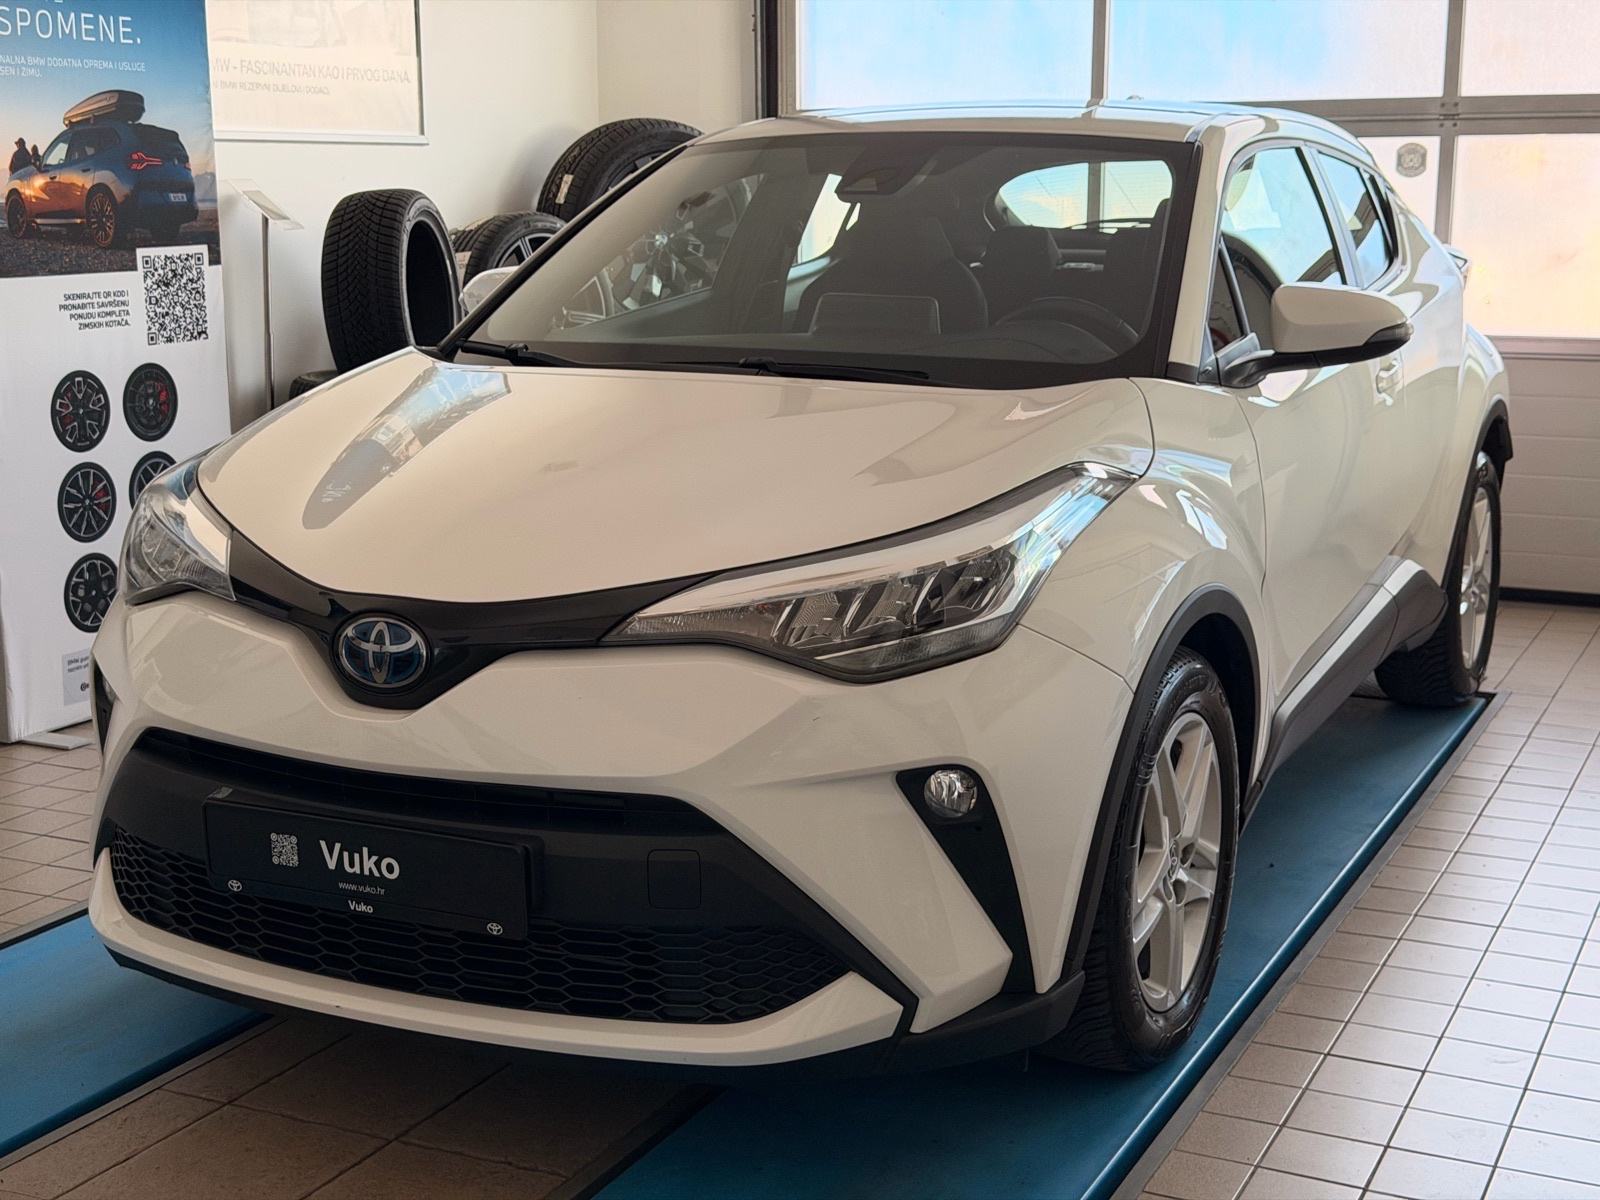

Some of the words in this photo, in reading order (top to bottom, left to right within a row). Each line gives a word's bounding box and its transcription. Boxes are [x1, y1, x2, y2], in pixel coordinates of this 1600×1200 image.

[0, 6, 141, 44] SPOMENE.
[27, 56, 46, 66] BMW
[47, 56, 82, 68] DODATNA
[83, 58, 113, 69] OPREMA
[118, 61, 146, 72] USLUGE
[239, 58, 317, 79] FASCINANTAN
[318, 64, 340, 80] KAO
[346, 67, 381, 82] PRVOG
[64, 291, 102, 301] SKENIRAJTE
[103, 291, 111, 299] QR
[113, 290, 125, 298] KOD
[96, 299, 129, 309] SAVRŠENU
[70, 311, 96, 321] PONUDU
[97, 310, 130, 319] KOMPLETA
[78, 321, 104, 331] ZIMSKIH
[319, 840, 400, 880] Vuko
[338, 881, 385, 895] www.vuko.hr
[348, 900, 374, 914] Vuko
